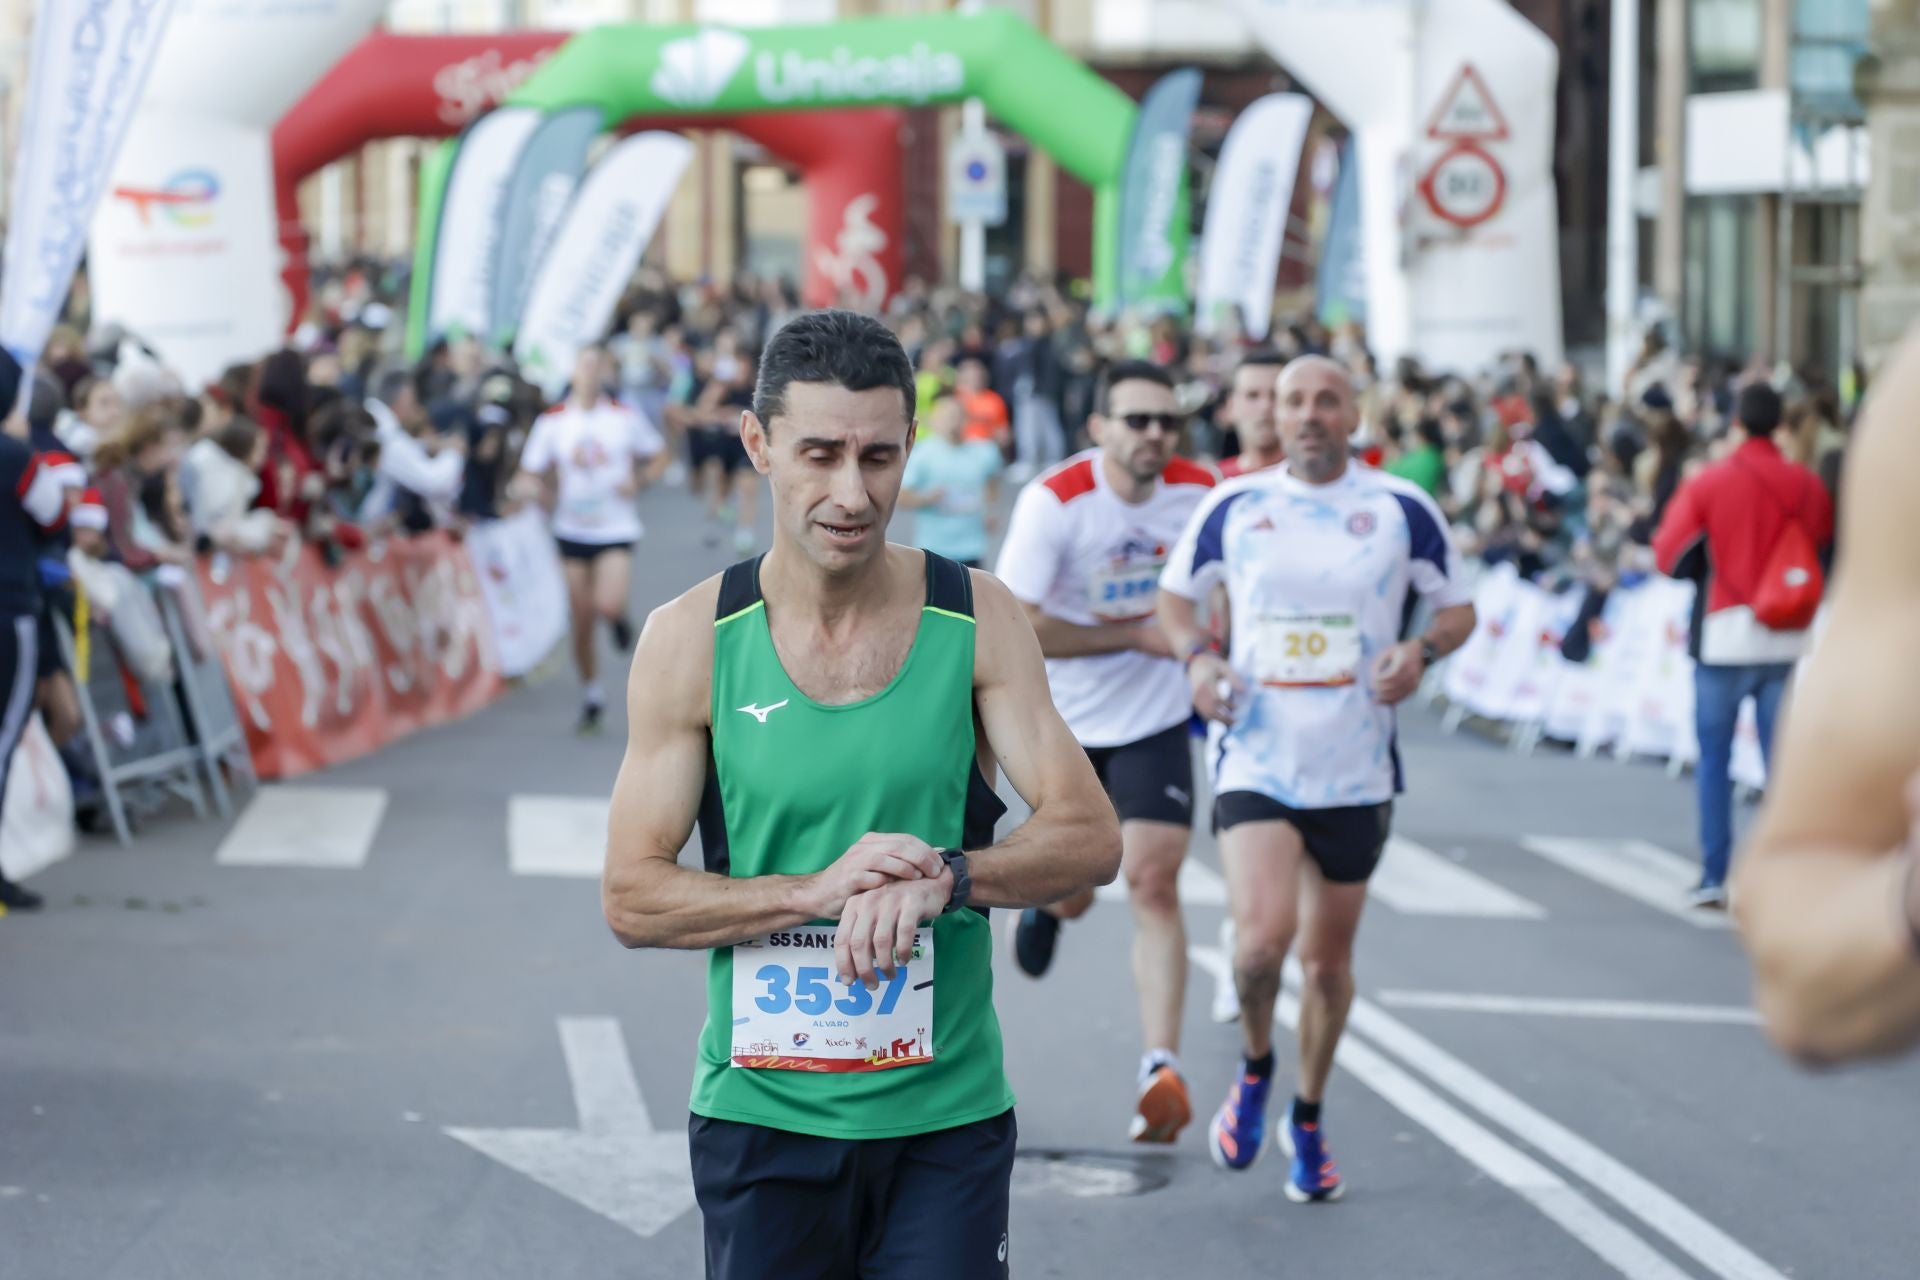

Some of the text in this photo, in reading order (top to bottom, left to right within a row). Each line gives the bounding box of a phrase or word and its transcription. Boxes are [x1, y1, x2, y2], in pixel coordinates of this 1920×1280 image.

[756, 42, 964, 103] Unicaja
[1284, 632, 1327, 657] 20
[769, 932, 791, 947] 55
[793, 933, 828, 949] SAN
[754, 964, 908, 1017] 3537
[812, 1020, 849, 1029] ALVARO
